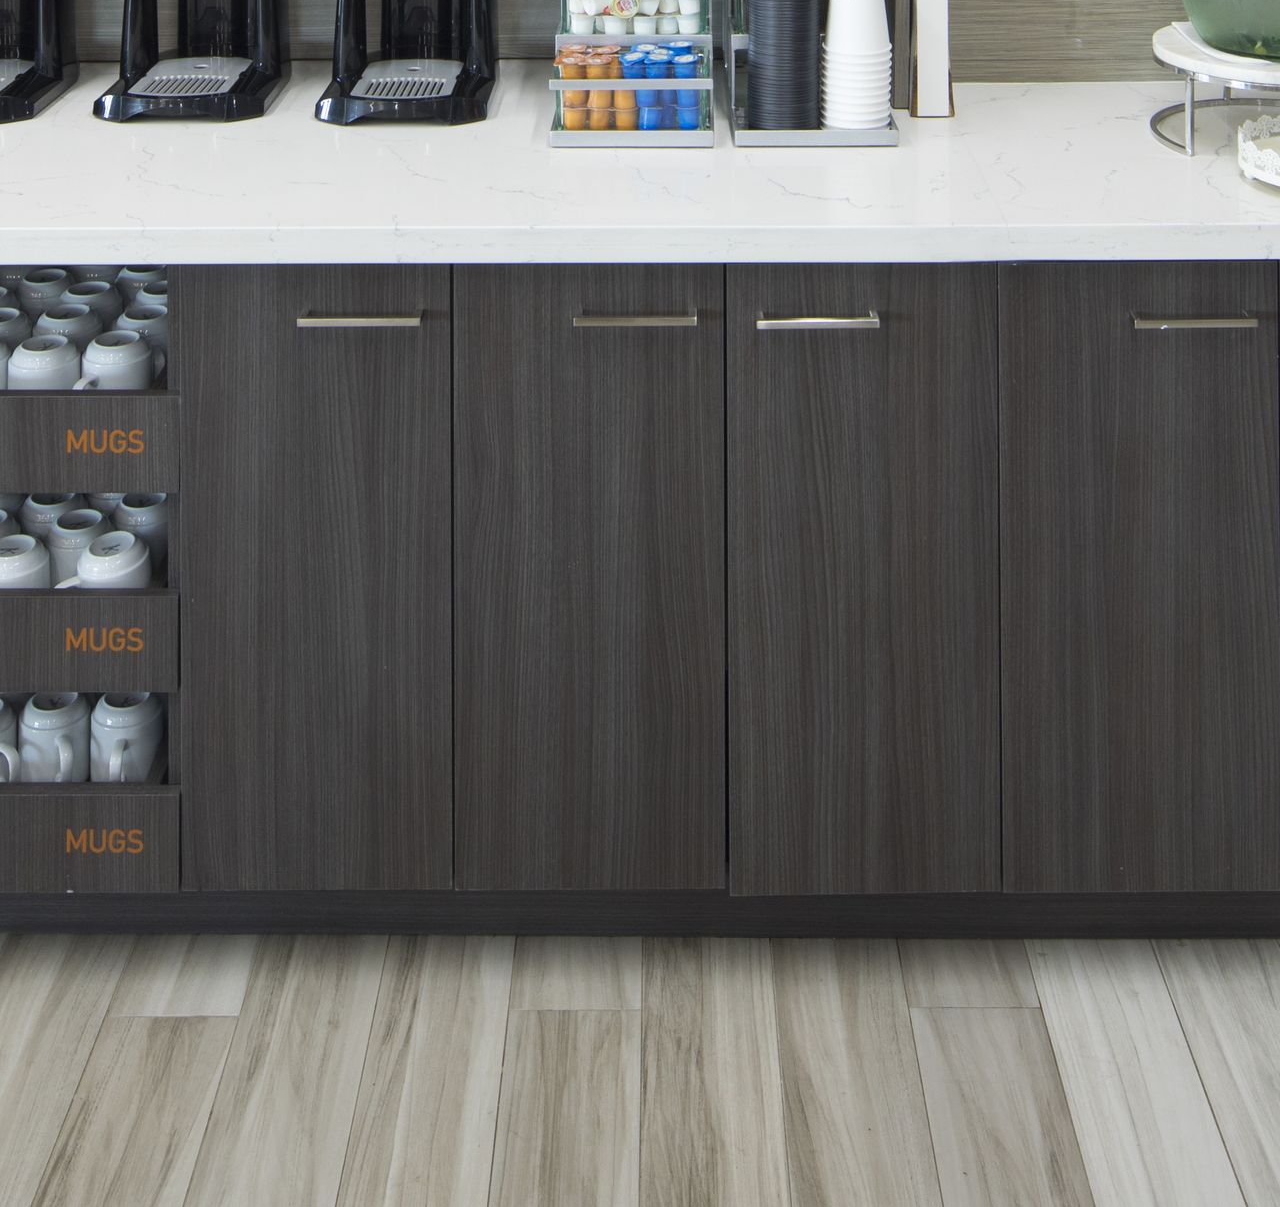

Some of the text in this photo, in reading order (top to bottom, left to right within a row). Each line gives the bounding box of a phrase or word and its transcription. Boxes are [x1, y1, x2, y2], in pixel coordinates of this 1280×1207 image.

[66, 429, 145, 455] MUGS
[66, 627, 145, 652] MUGS
[66, 829, 145, 854] MUGS
